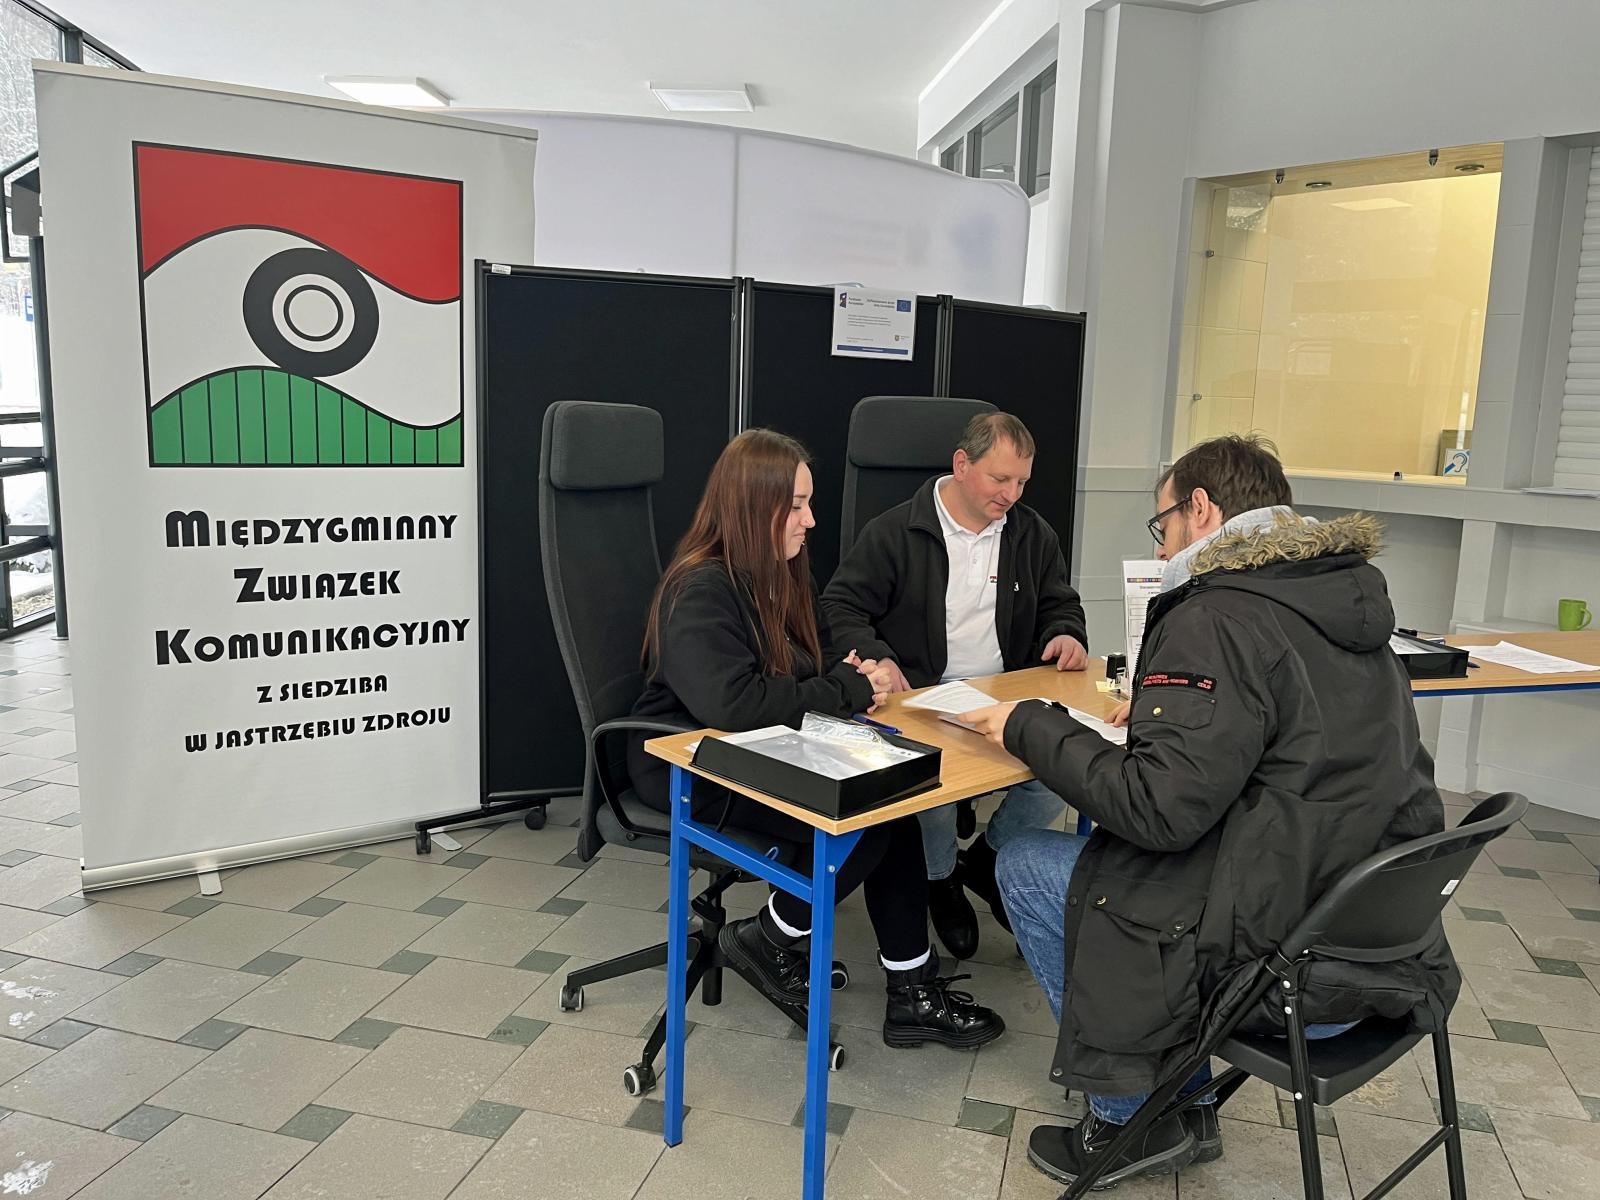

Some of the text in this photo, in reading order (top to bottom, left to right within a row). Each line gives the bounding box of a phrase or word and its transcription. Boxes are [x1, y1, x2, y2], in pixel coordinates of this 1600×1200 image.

[155, 618, 471, 666] KOMUNIKACYJNY
[256, 685, 273, 704] Z
[185, 733, 207, 753] W
[362, 706, 451, 733] ZDROJU
